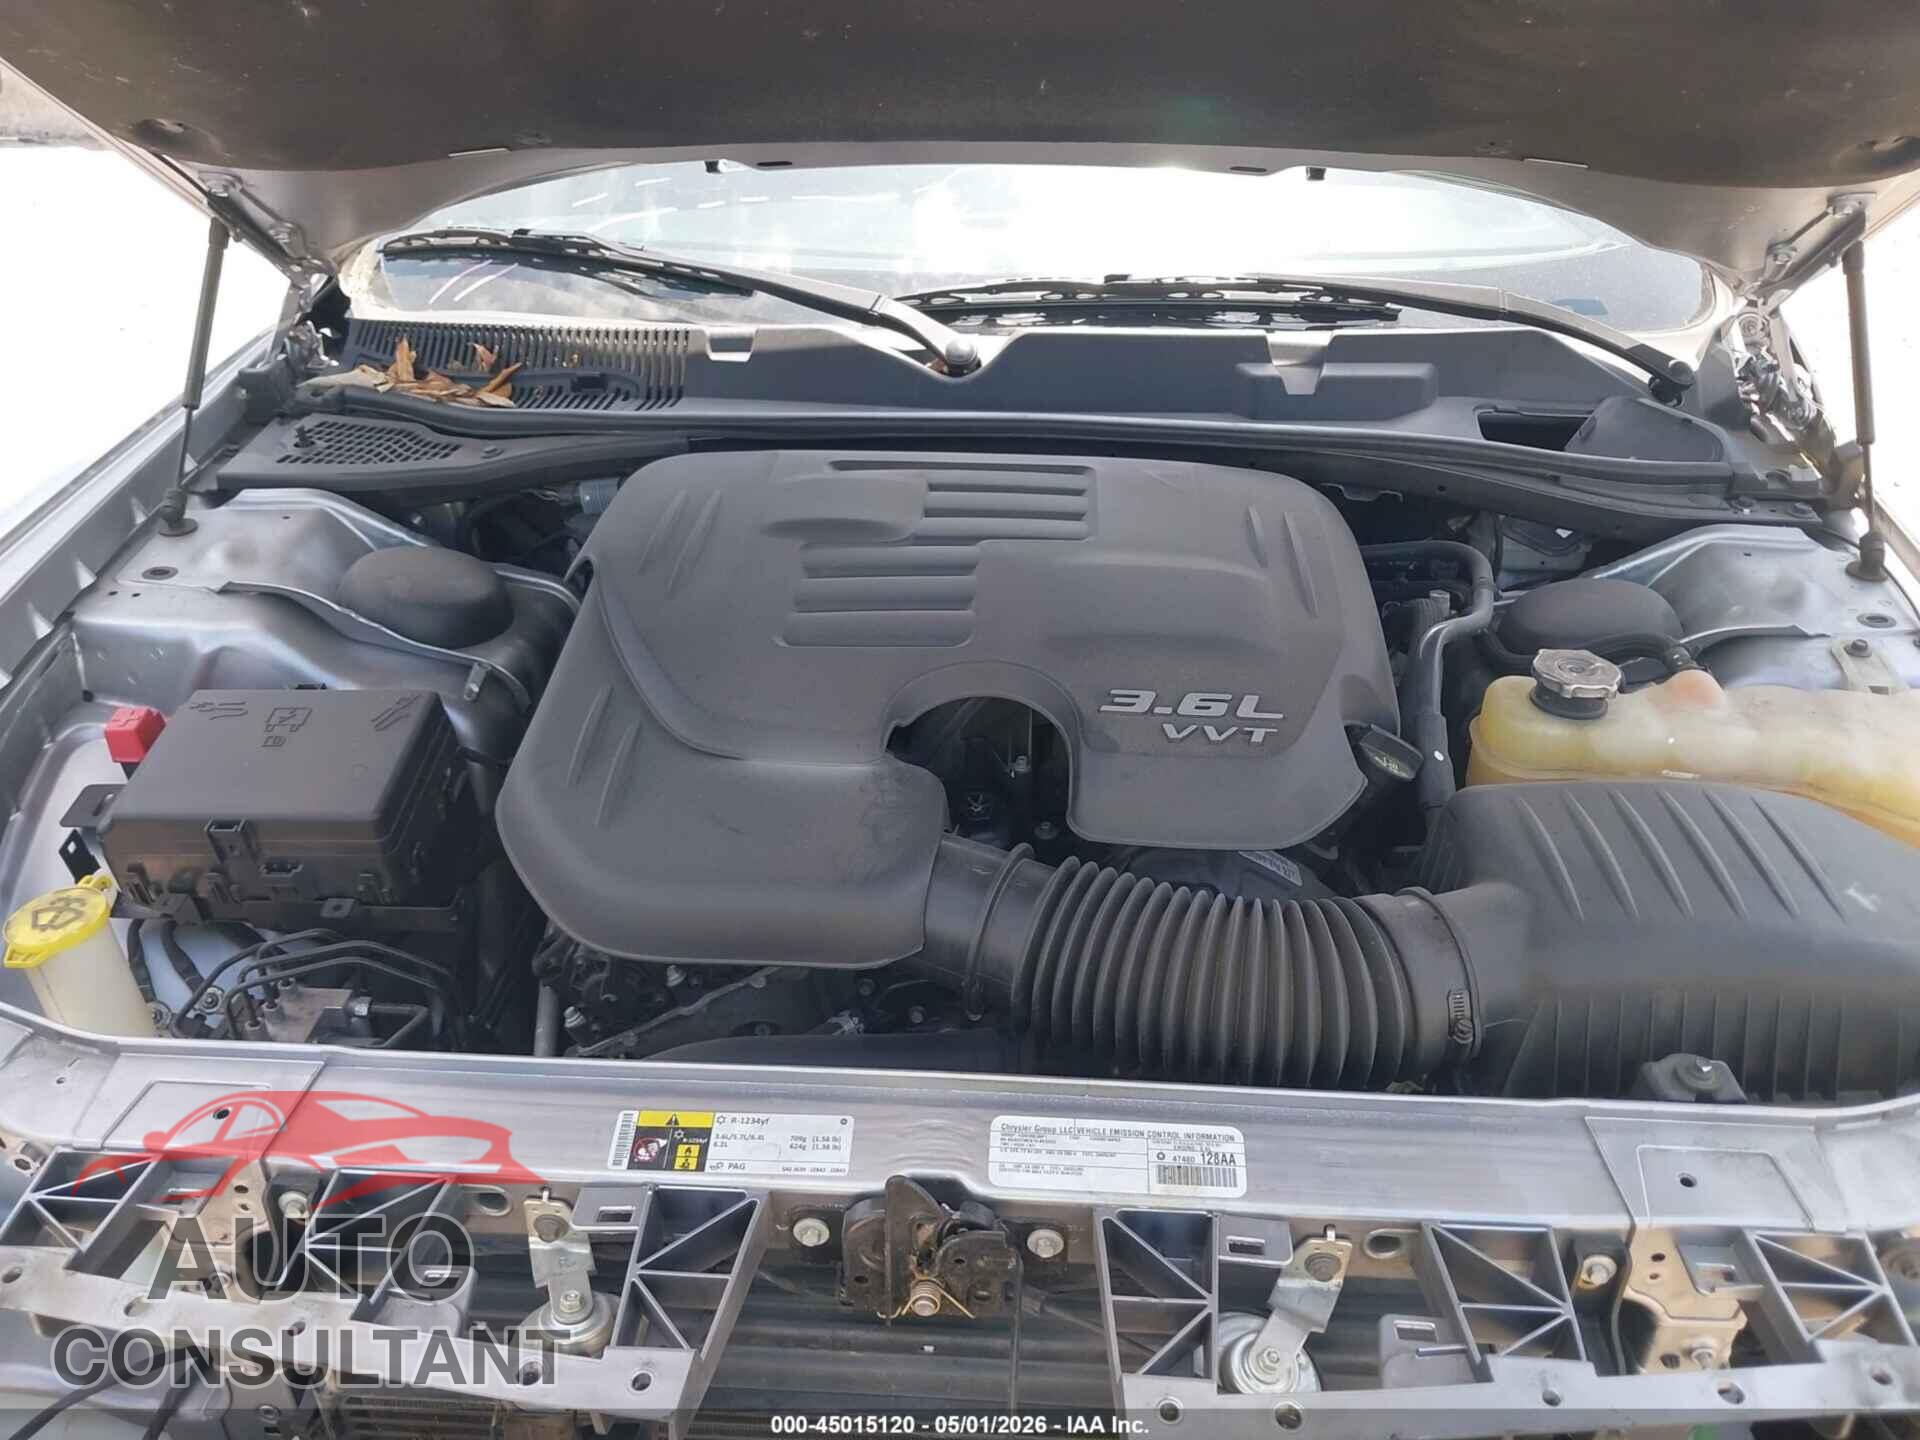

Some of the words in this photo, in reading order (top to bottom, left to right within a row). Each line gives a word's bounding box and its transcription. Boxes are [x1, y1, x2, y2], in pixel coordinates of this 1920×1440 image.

[1100, 689, 1284, 719] 3.6L
[1162, 723, 1279, 743] VVT
[730, 1117, 770, 1126] R-1234yf
[1001, 1123, 1032, 1133] Chrysler
[1075, 1127, 1107, 1136] VEHICLE
[1109, 1128, 1145, 1137] EMISSION
[1147, 1130, 1182, 1139] CONTROL
[1183, 1132, 1235, 1142] INFORMATION
[727, 1162, 746, 1170] PAG
[1200, 1152, 1236, 1166] 128AA
